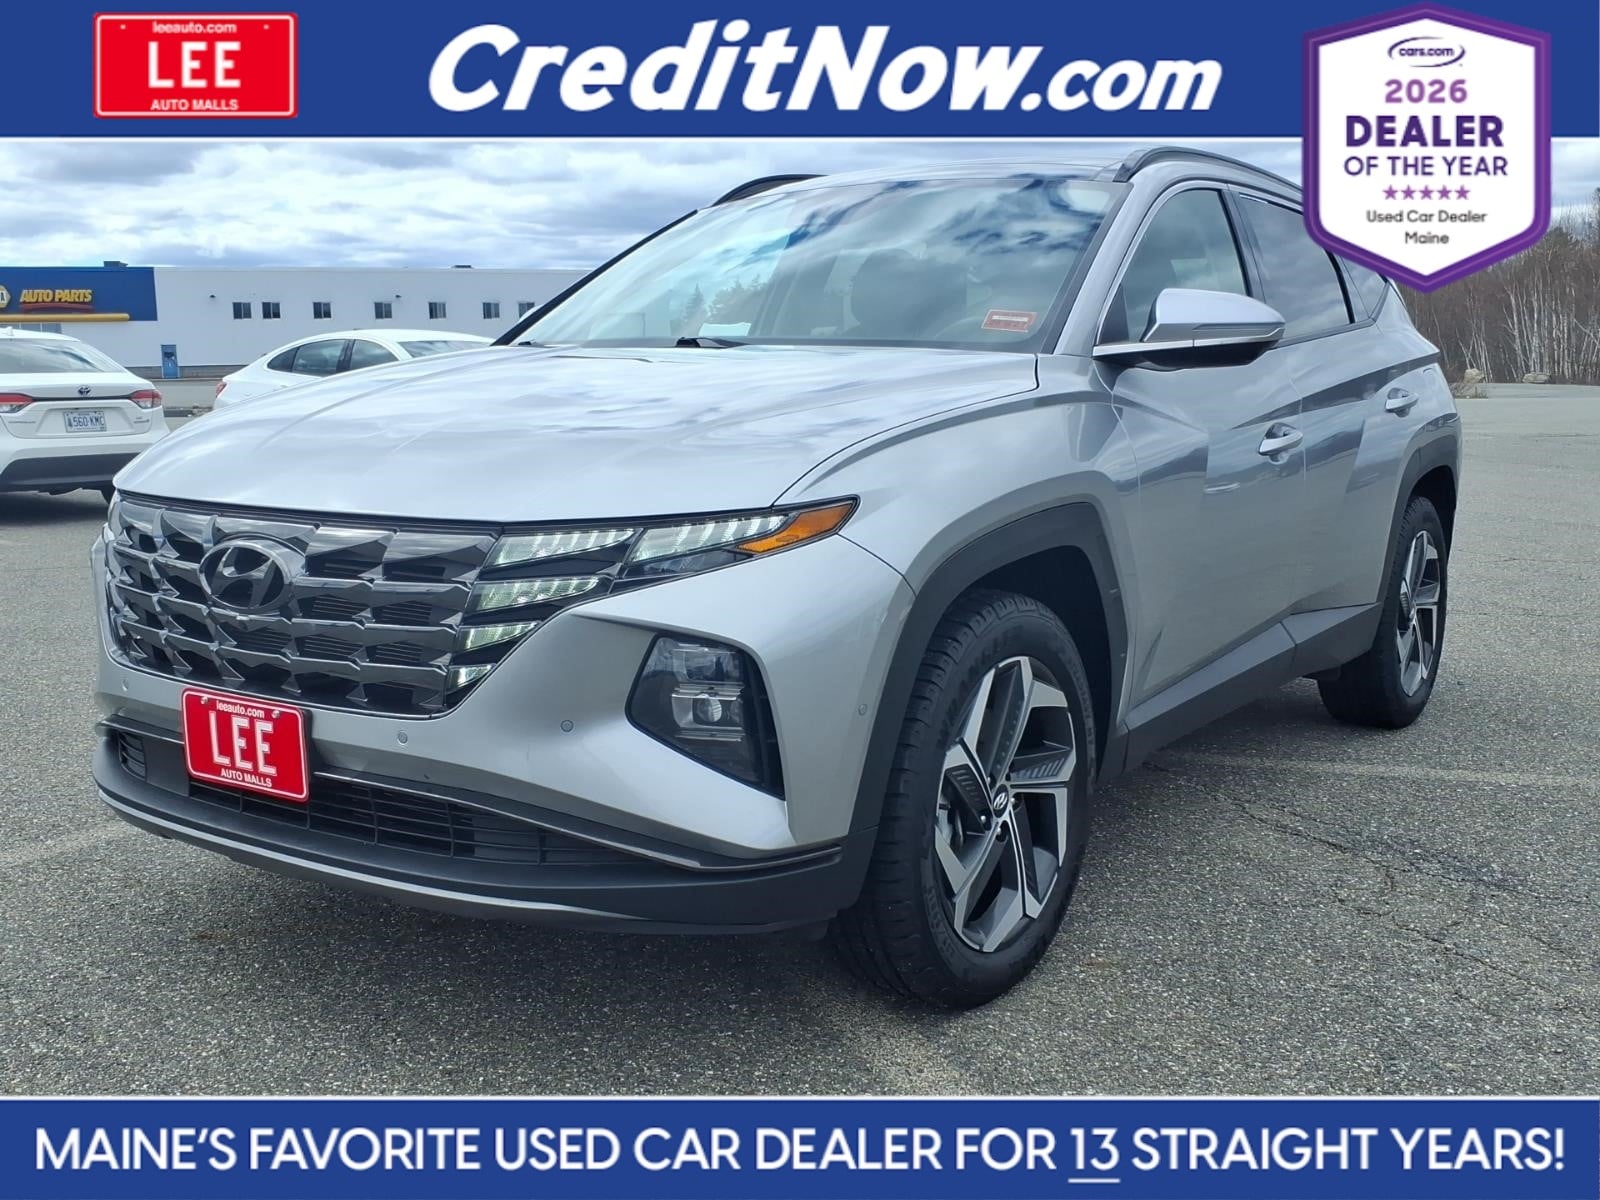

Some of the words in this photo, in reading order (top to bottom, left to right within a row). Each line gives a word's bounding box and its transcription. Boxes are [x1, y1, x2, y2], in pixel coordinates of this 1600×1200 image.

[21, 290, 54, 302] AUTO
[54, 290, 92, 302] PARTS
[217, 701, 265, 719] leeauto.com
[209, 712, 277, 776] LEE
[221, 769, 243, 780] AUTO
[245, 775, 273, 787] MALLS
